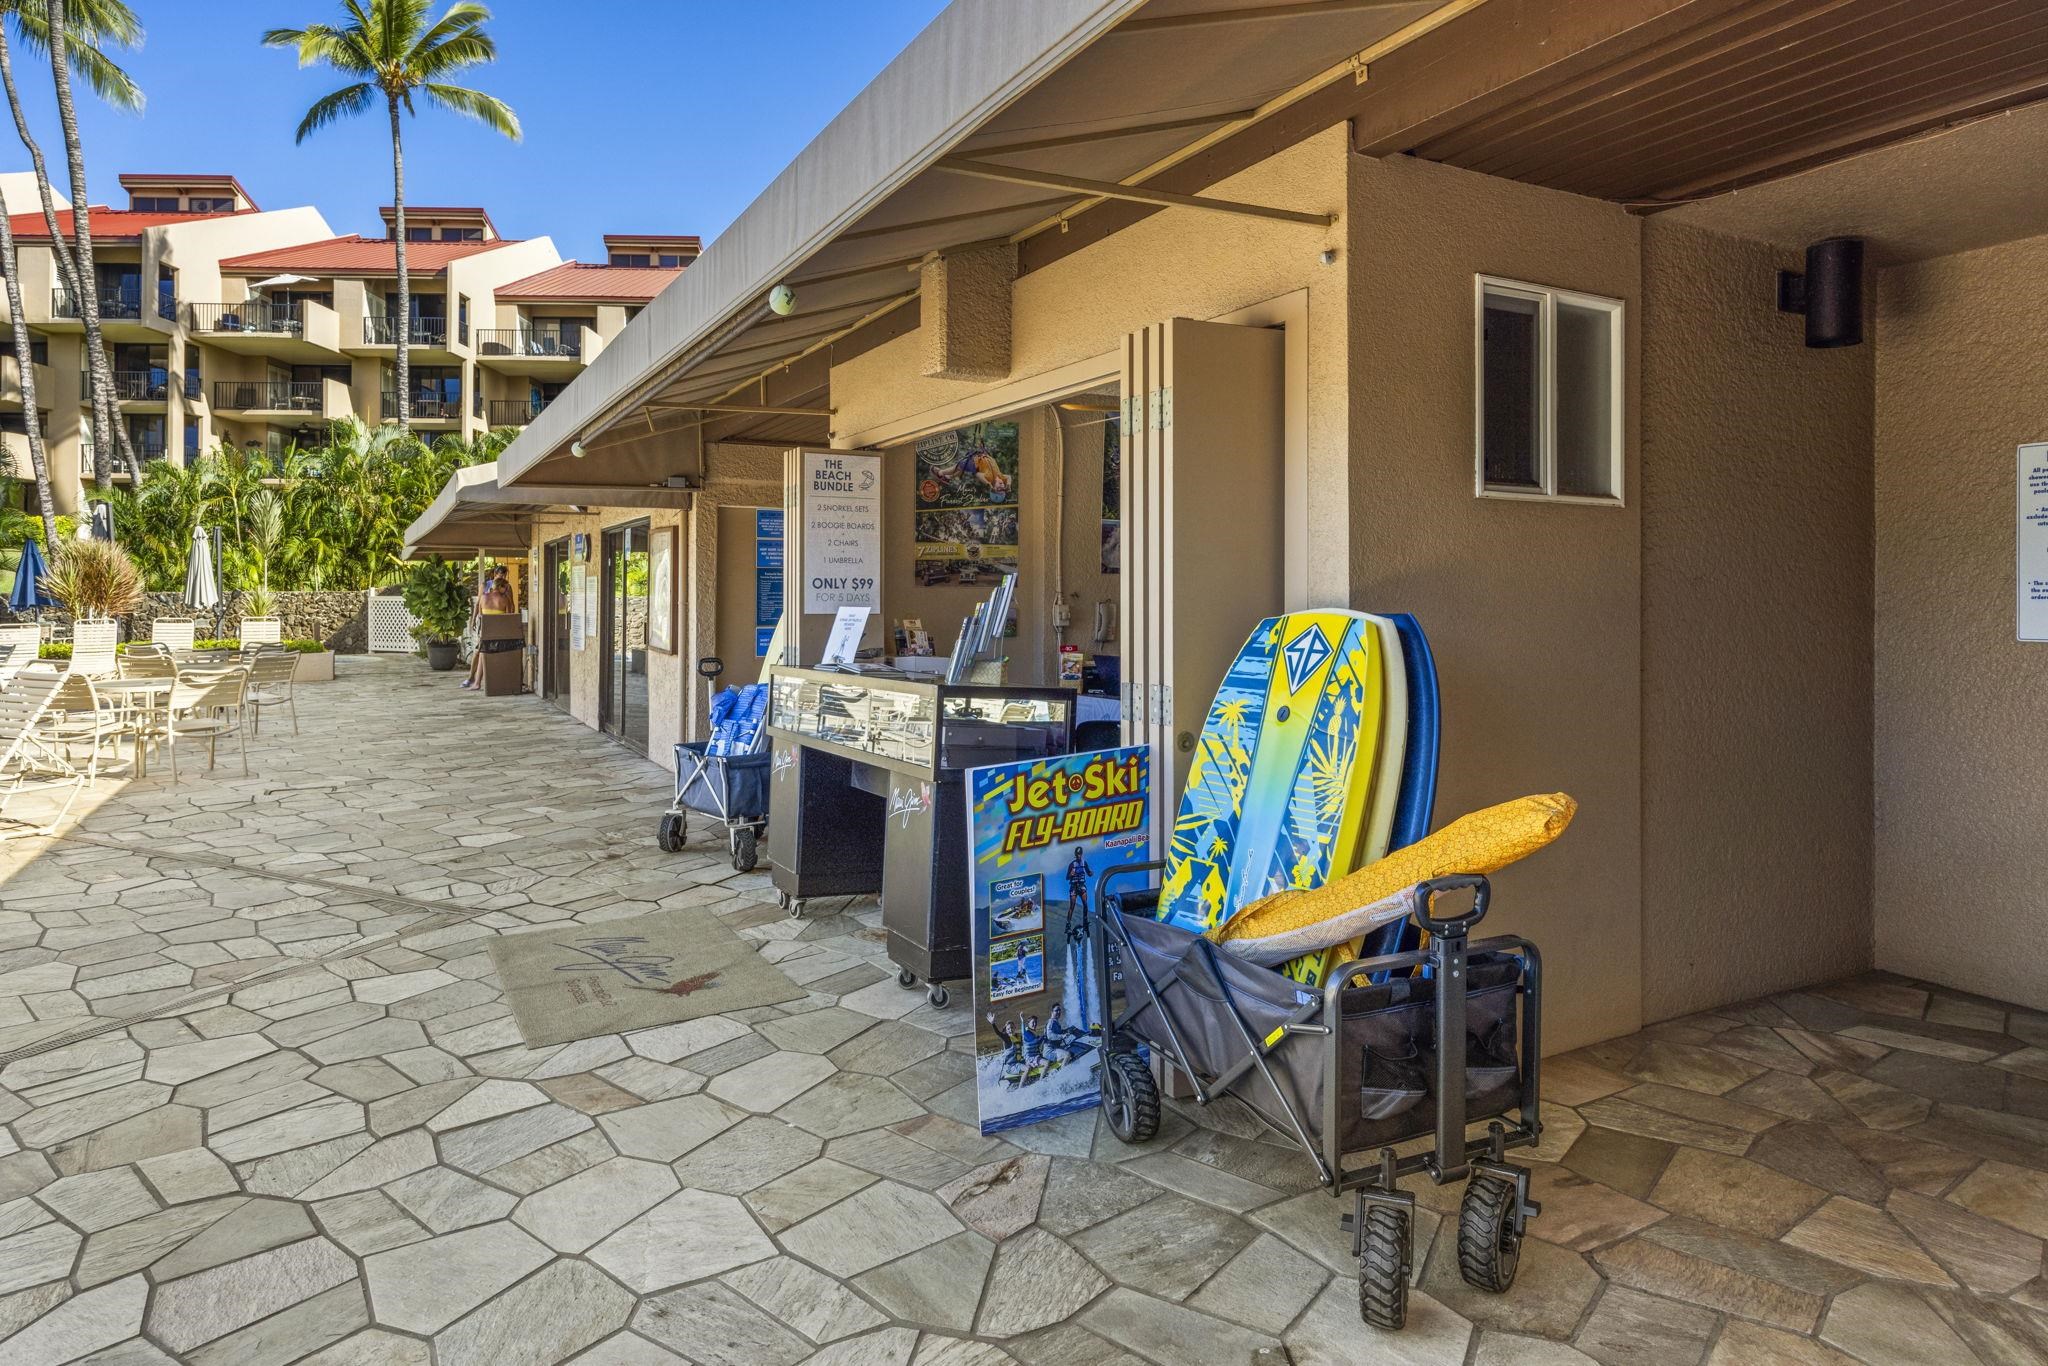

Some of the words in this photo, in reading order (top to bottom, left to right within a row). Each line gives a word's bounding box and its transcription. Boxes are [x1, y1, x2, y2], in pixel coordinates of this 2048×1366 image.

[824, 459, 843, 470] THE
[815, 470, 852, 481] BEACH
[813, 480, 854, 492] BUNDLE
[817, 503, 822, 511] 2
[823, 504, 854, 512] SNORKEL
[855, 505, 869, 513] SETS
[811, 520, 816, 529] 2
[817, 521, 846, 530] BOOGIE
[846, 522, 875, 530] BOARDS
[833, 539, 859, 547] CHAIRS
[812, 577, 848, 590] ONLY
[851, 577, 874, 591] $99
[816, 592, 836, 602] FOR
[838, 592, 844, 602] 5
[846, 592, 871, 602] DAYS
[1008, 770, 1068, 814] Jet
[1084, 756, 1139, 800] Ski
[1004, 799, 1145, 853] FLY-BOARD
[996, 882, 1013, 891] Great
[1010, 885, 1036, 896] Couples!
[1014, 982, 1041, 993] Beginners!
